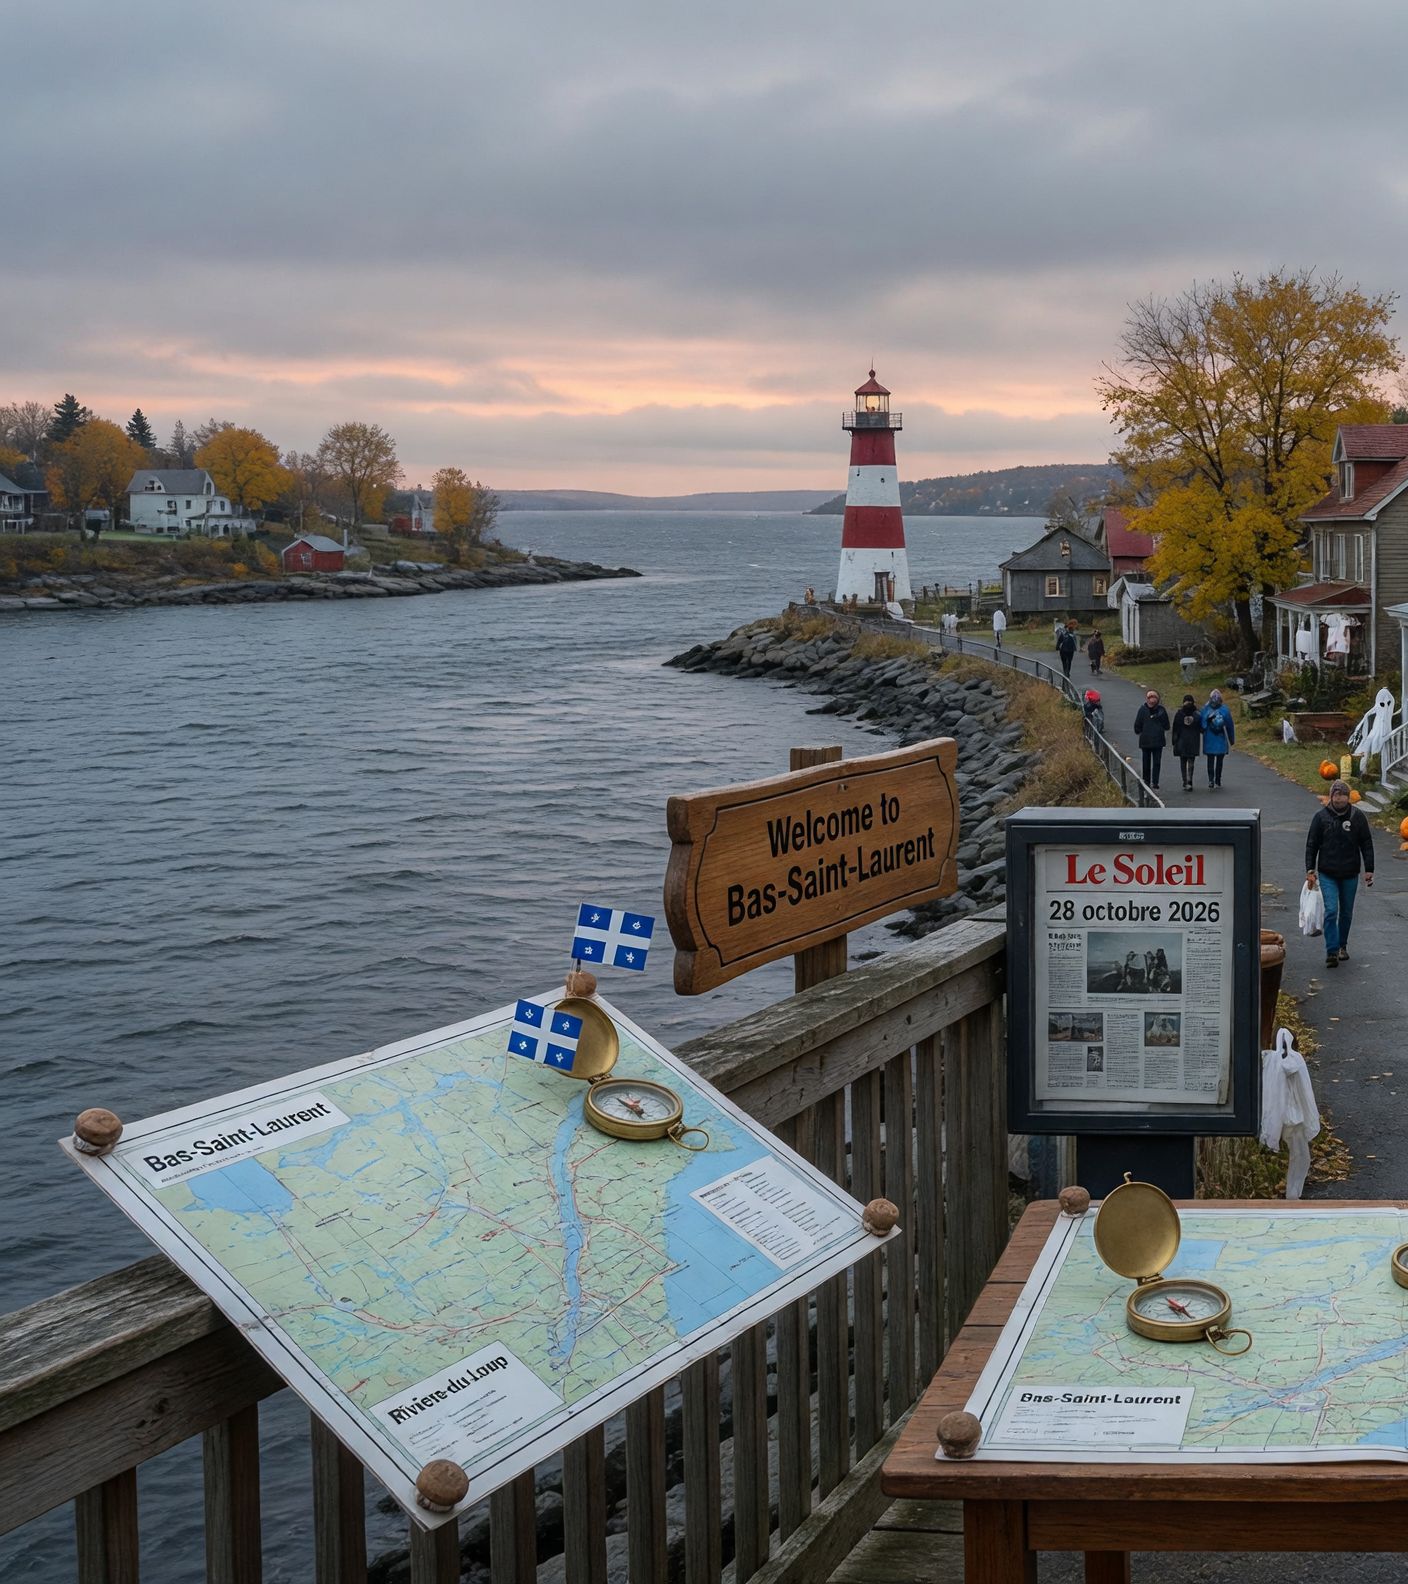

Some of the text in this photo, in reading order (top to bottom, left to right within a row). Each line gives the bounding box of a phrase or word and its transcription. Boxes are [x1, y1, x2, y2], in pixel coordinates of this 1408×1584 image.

[766, 793, 899, 858] Welcome to
[727, 826, 936, 927] Bas-Saint-Laurent
[1065, 853, 1206, 886] Le Soleil
[1049, 900, 1220, 923] 28 octobre 2026
[143, 1101, 332, 1173] Bas-Saint-Laurent
